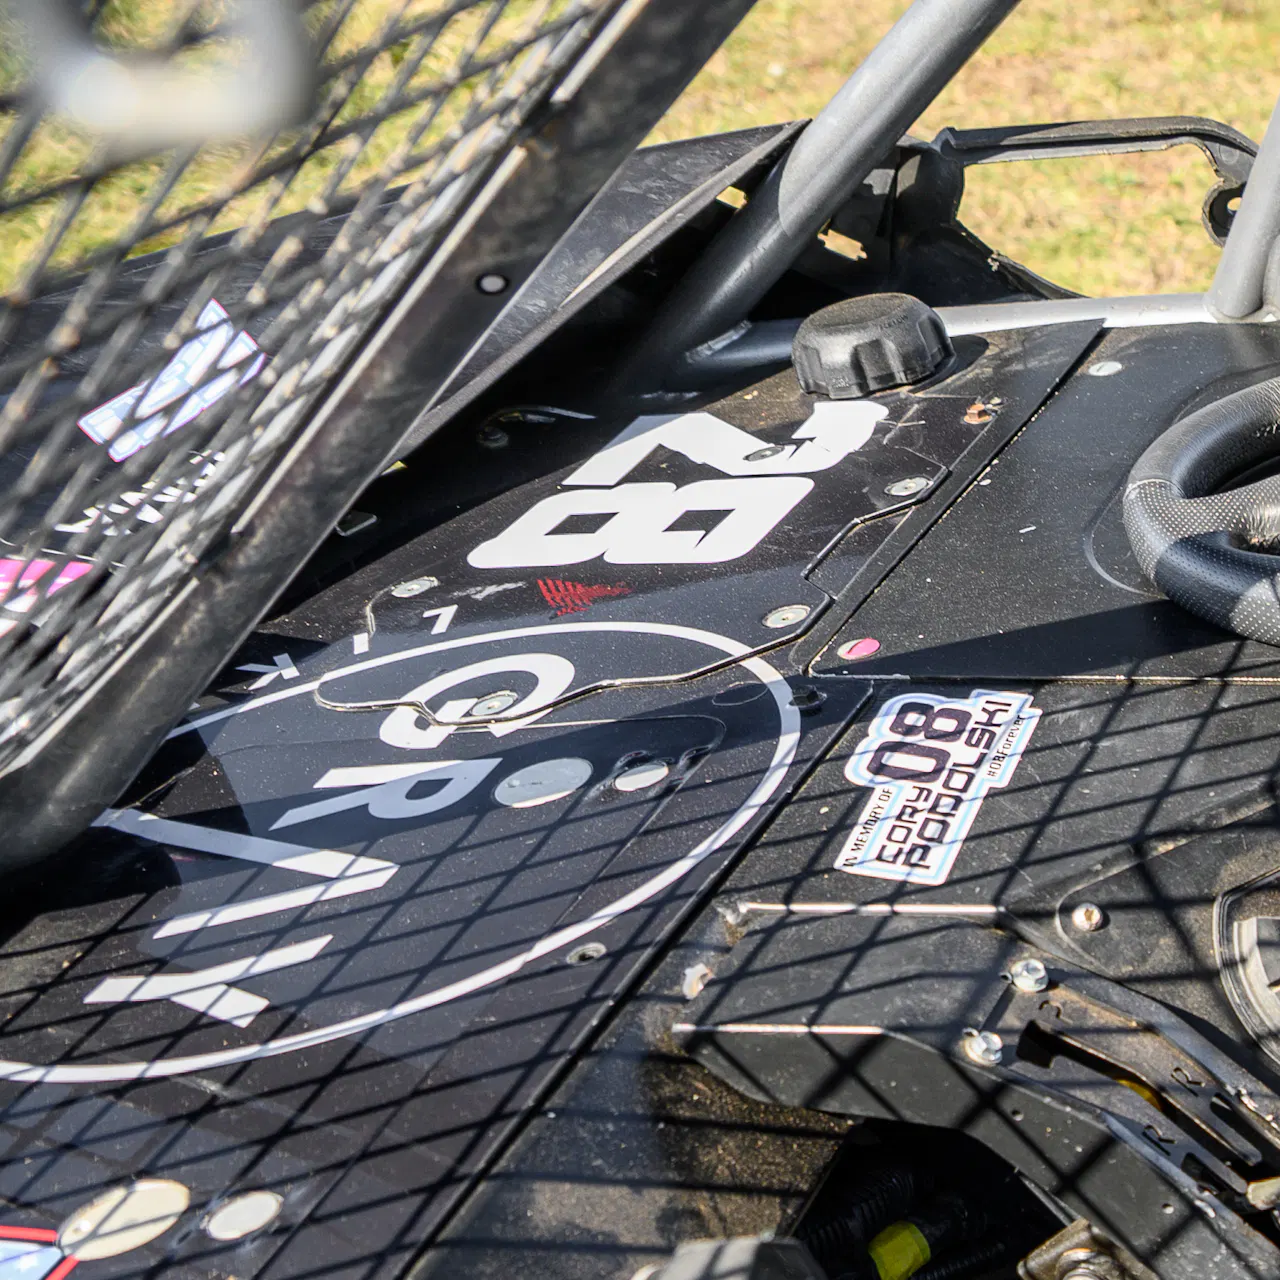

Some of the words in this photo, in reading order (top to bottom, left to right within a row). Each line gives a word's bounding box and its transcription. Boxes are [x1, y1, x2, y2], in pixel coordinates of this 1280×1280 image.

[467, 400, 889, 569] 28
[866, 701, 973, 784] 08
[876, 785, 933, 865] CORY
[902, 700, 1012, 870] PODOLSKI
[843, 854, 858, 867] IN
[851, 803, 882, 854] MEMORY
[879, 787, 893, 803] OF
